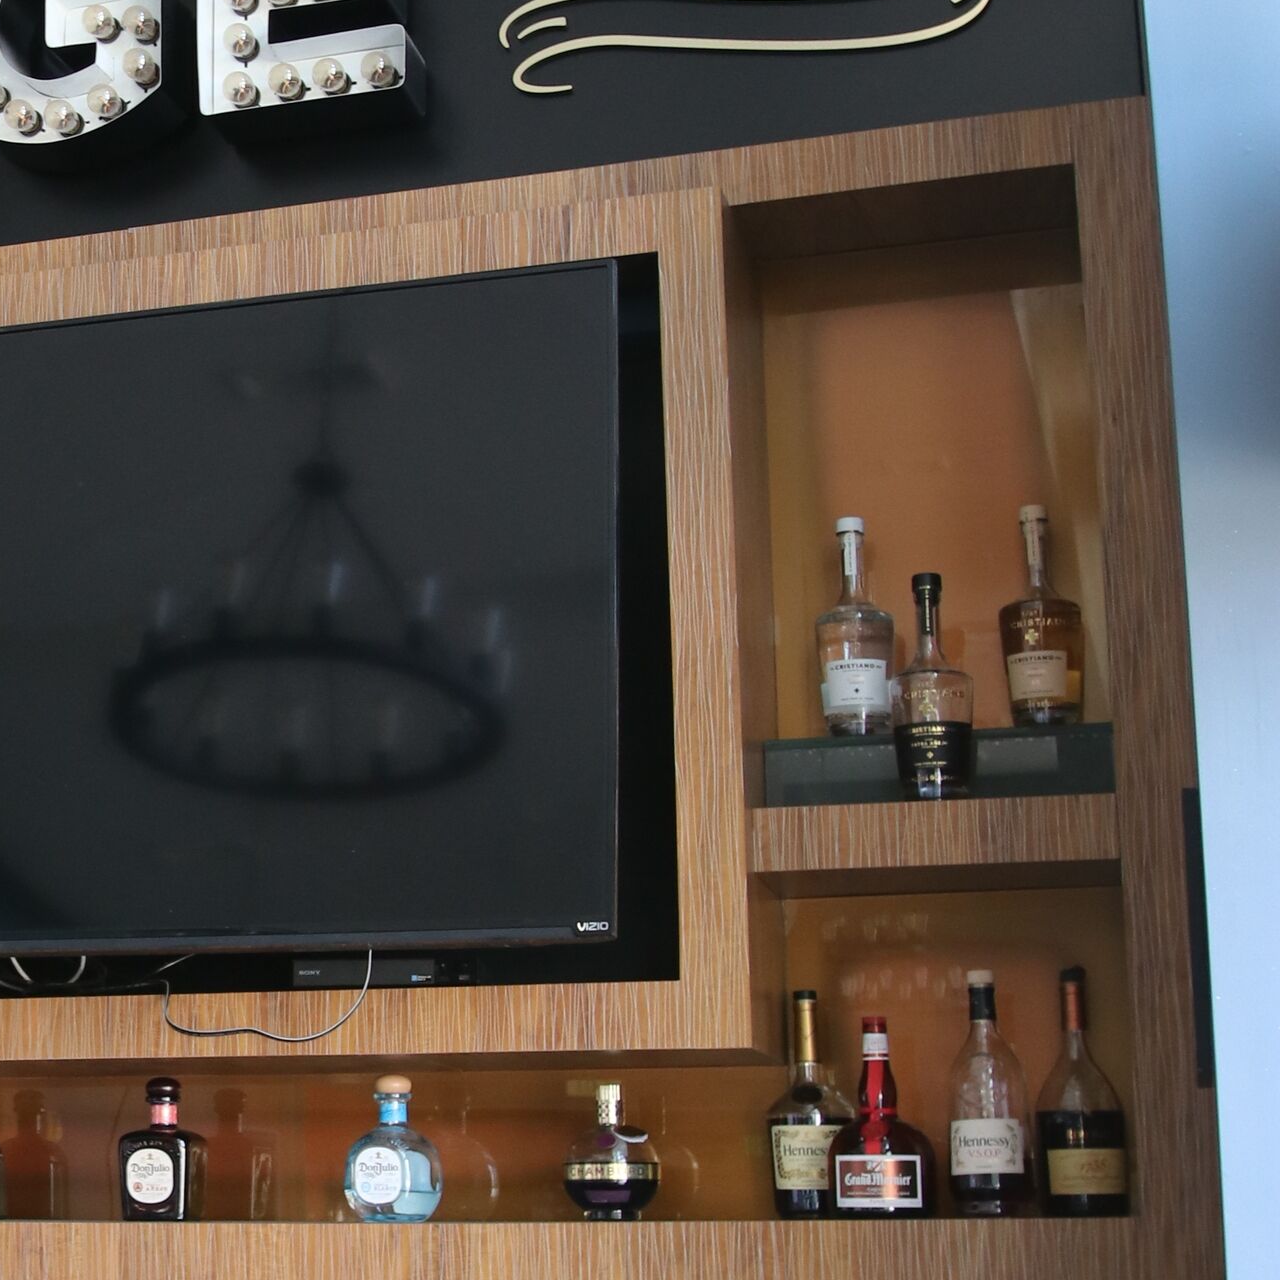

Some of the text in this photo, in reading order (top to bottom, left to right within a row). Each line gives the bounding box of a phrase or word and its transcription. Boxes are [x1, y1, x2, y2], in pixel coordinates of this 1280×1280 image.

[576, 921, 609, 932] VIZIO
[958, 1135, 1010, 1149] Hennessy
[782, 1144, 827, 1157] Hennes
[569, 1166, 646, 1178] CHAMBRD
[844, 1172, 871, 1186] Grand
